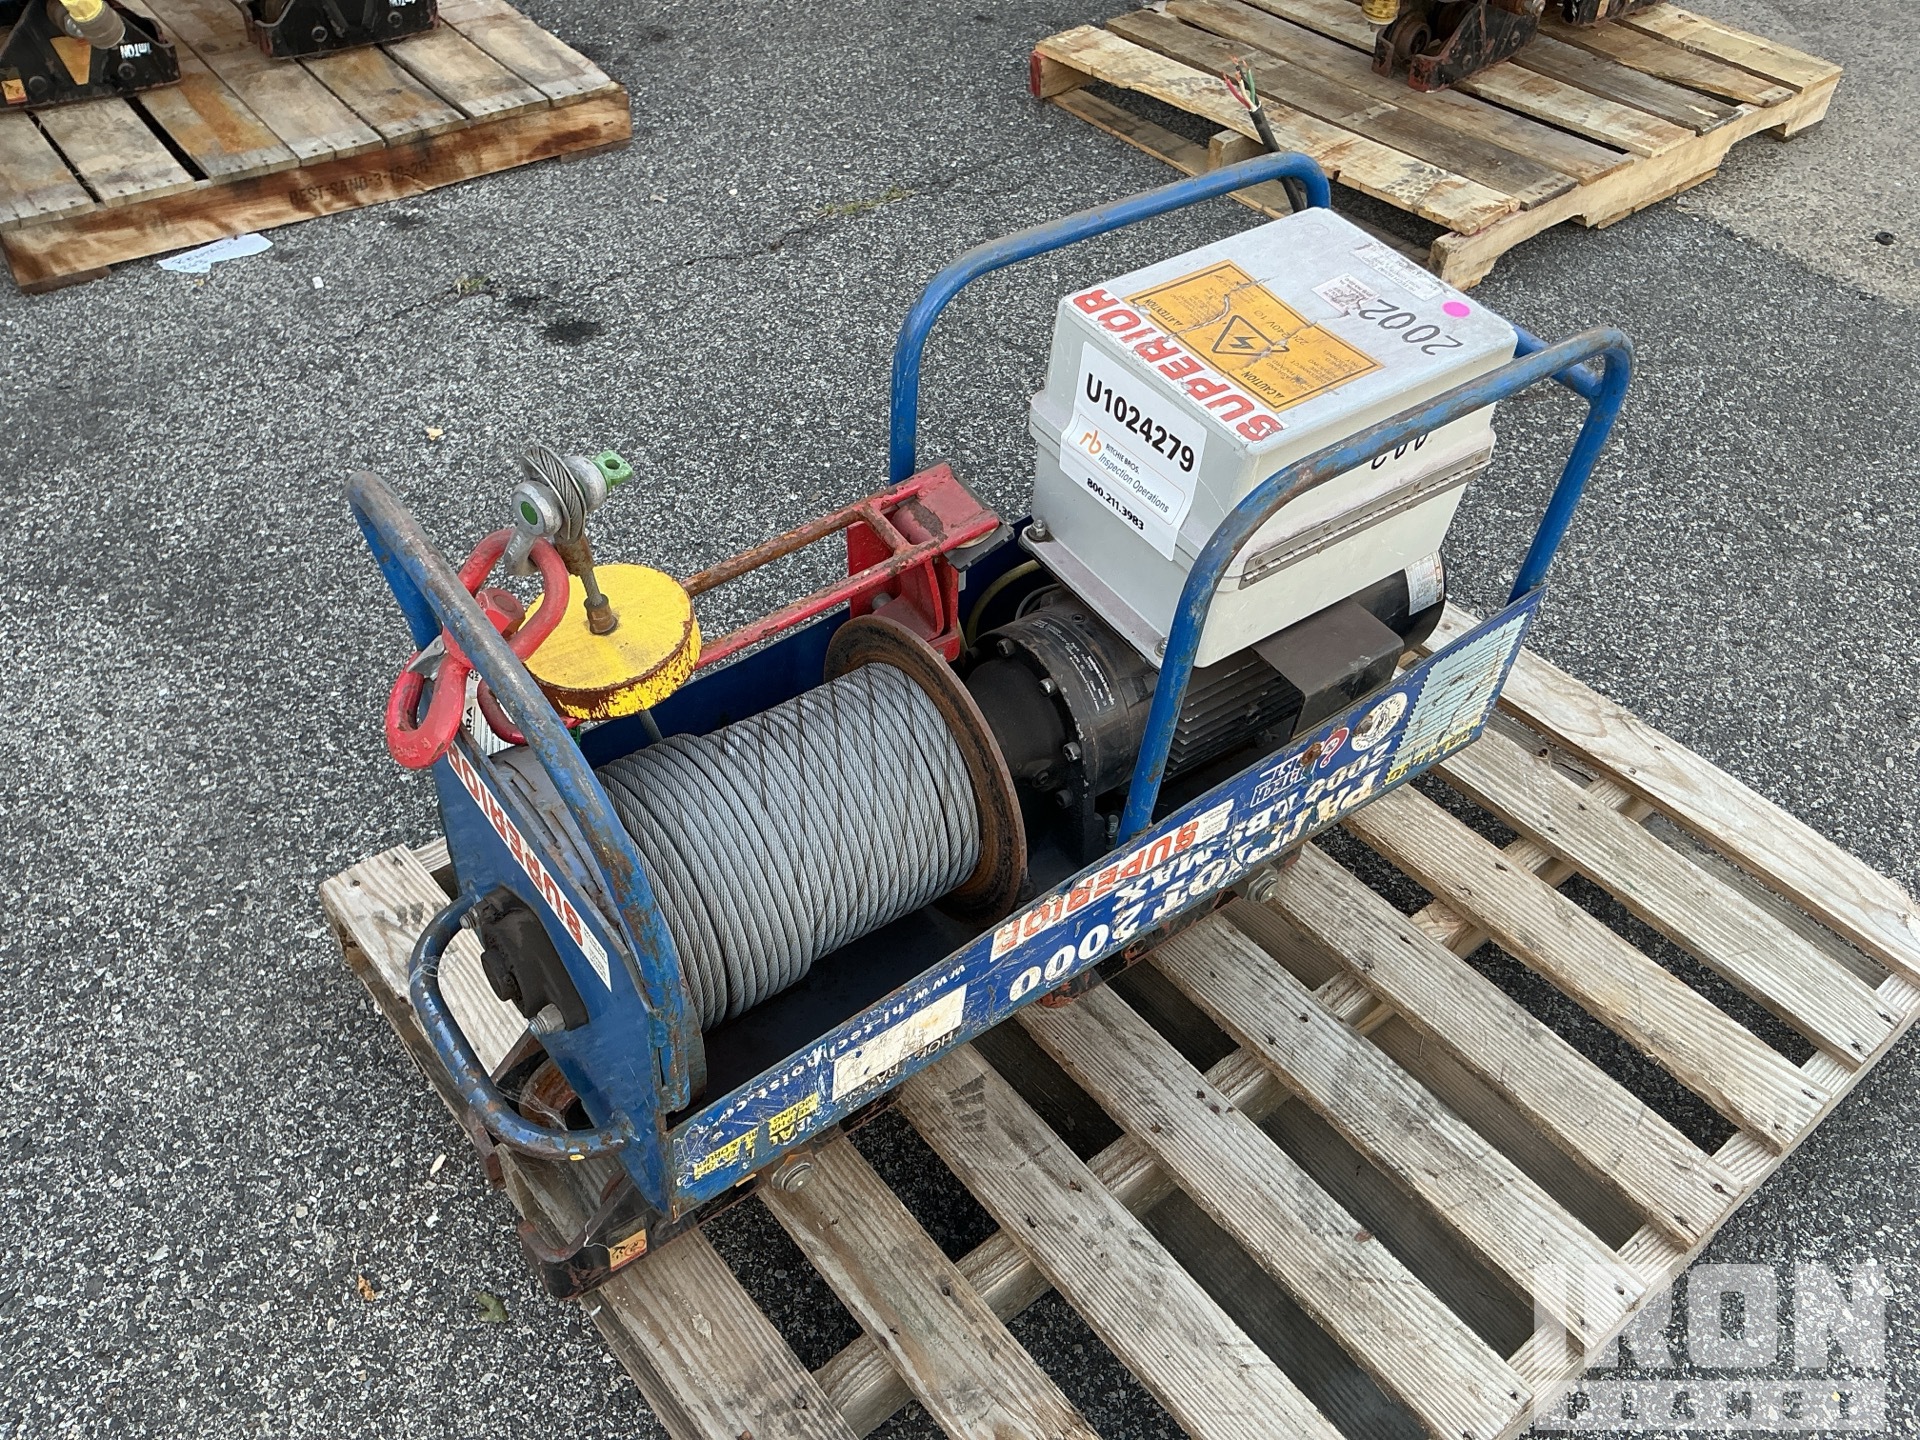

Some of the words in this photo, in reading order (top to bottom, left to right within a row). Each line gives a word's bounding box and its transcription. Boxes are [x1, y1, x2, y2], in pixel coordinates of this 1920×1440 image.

[1142, 298, 1179, 323] ATTENTION
[1360, 298, 1463, 356] 2002
[1073, 288, 1284, 442] SUPERIOR
[1240, 370, 1276, 394] CAUTION
[1087, 373, 1194, 472] U1024279
[1099, 452, 1133, 484] Inspection
[1133, 478, 1168, 513] Operations
[1106, 443, 1124, 462] RITCHIE
[1124, 457, 1139, 474] BROS.
[1086, 477, 1144, 530] 800.211.3983
[1302, 741, 1392, 803] 2000
[449, 744, 582, 946] SUPERIOR
[1222, 792, 1299, 848] LBS
[995, 821, 1199, 951] SUPERIOR
[1112, 840, 1211, 915] MAX
[1009, 900, 1139, 1003] 2000
